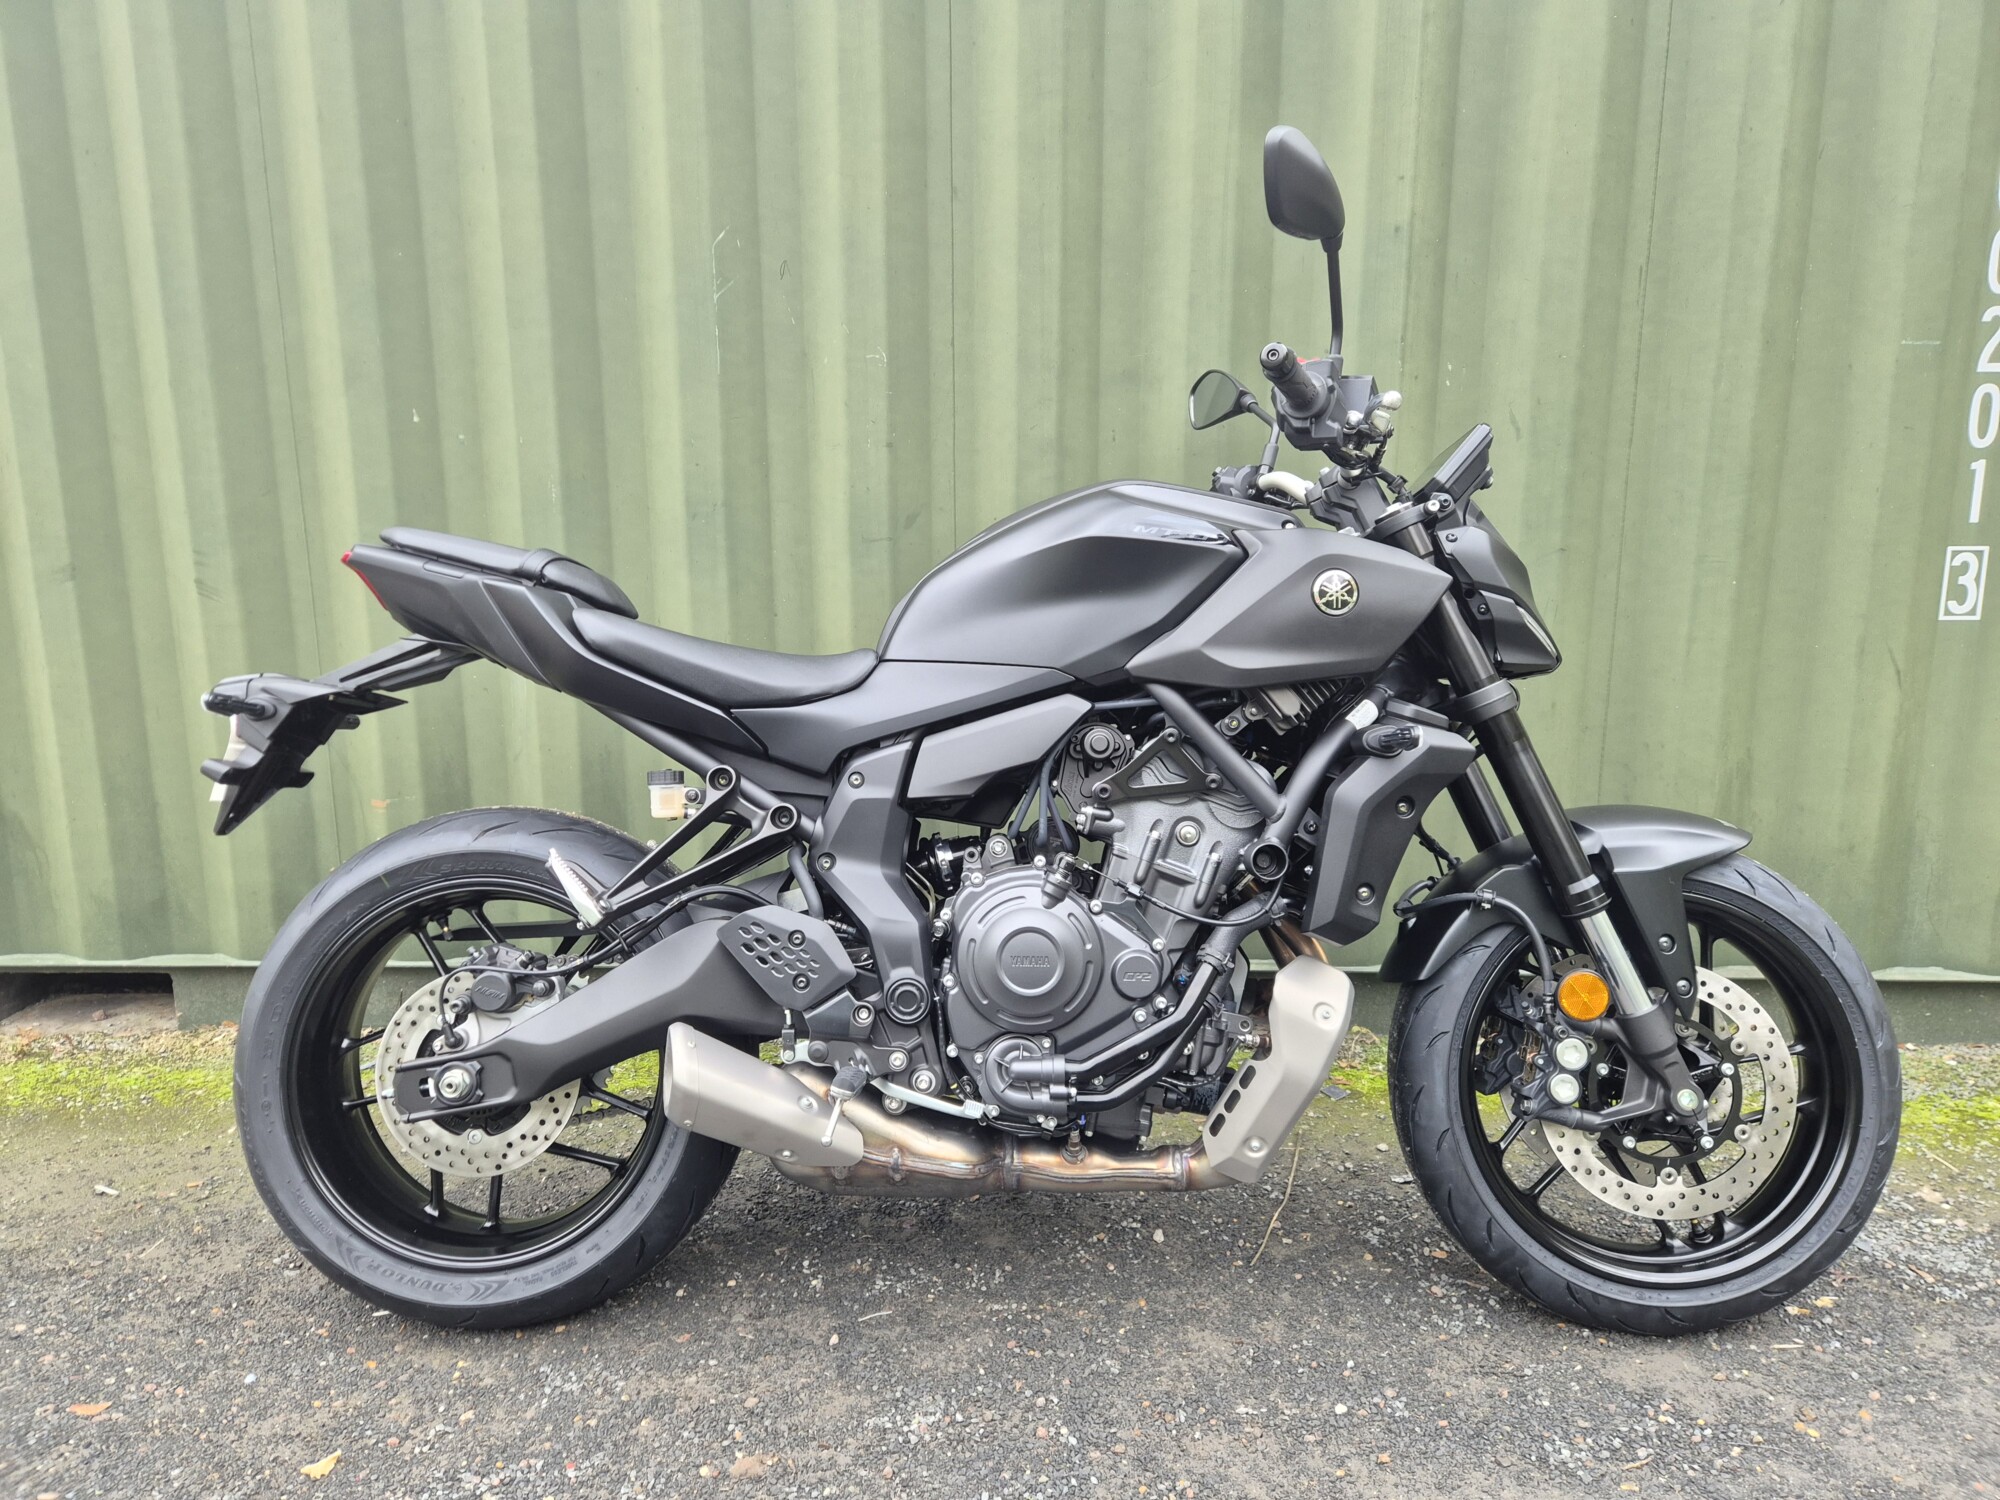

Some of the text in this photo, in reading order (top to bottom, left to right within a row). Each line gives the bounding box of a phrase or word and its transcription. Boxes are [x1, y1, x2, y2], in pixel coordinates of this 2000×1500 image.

[1945, 550, 1981, 615] 3
[1010, 955, 1051, 968] YAMAHA
[366, 1263, 447, 1292] DUNLOP
